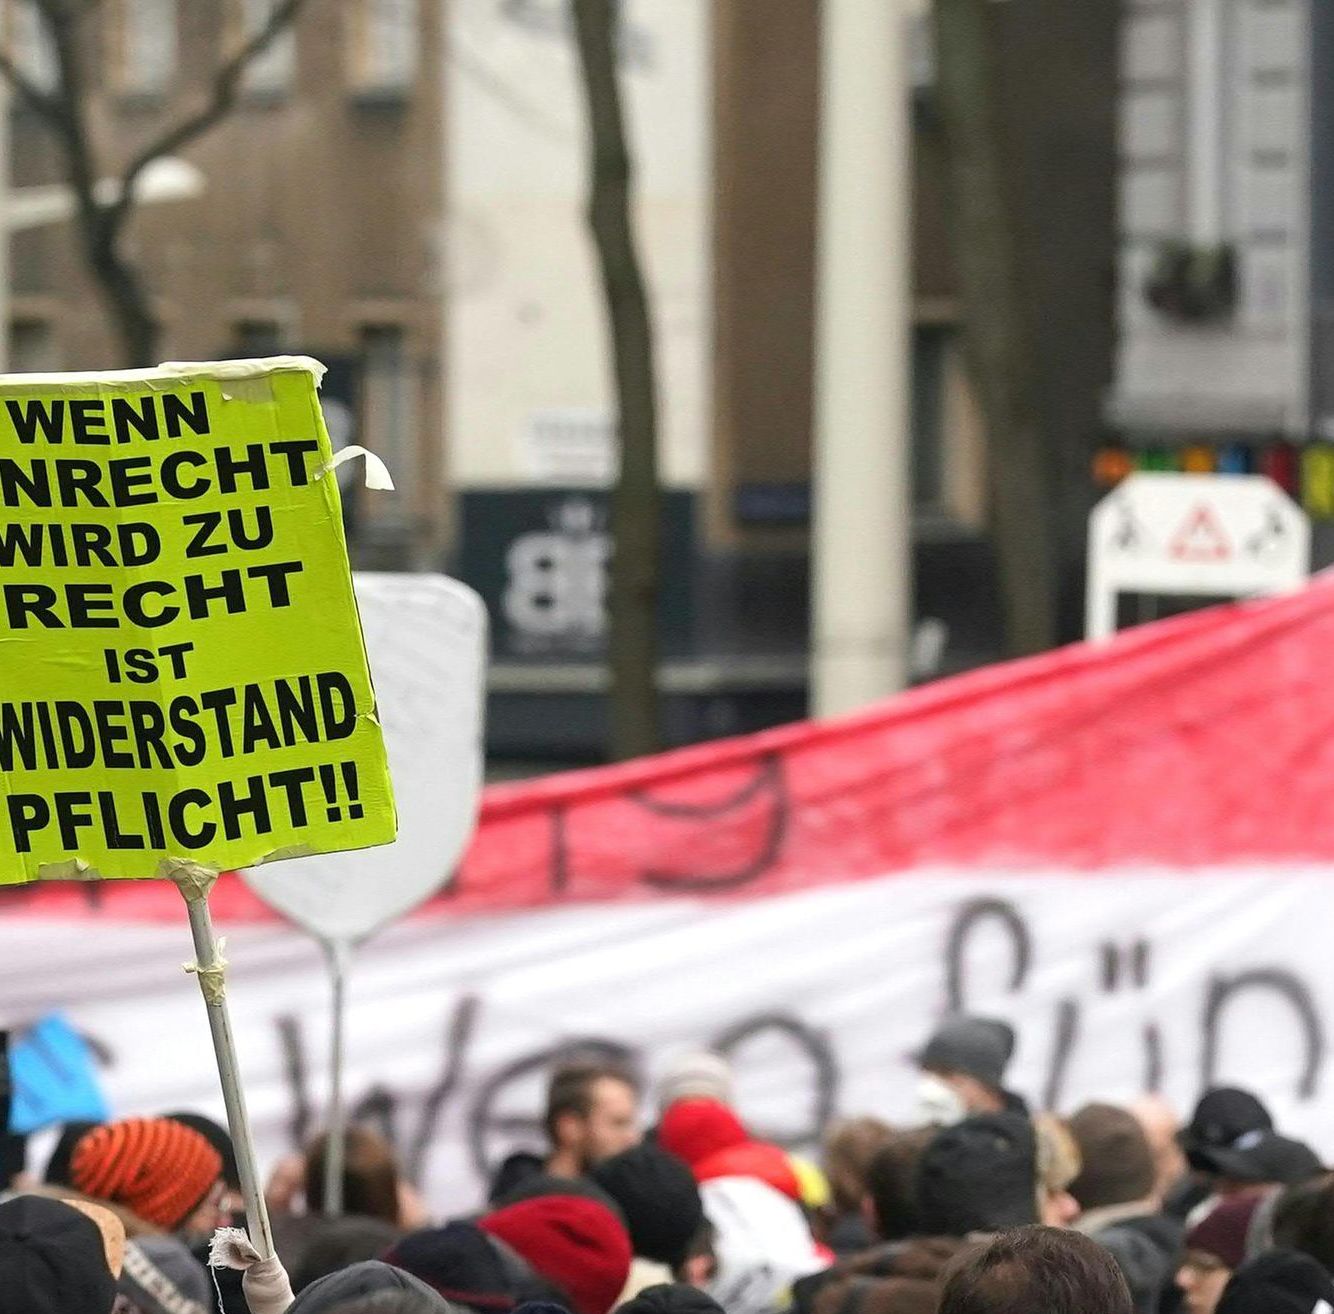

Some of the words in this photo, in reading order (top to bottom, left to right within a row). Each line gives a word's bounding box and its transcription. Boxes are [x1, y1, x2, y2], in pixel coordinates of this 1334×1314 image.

[5, 392, 210, 445] WENN
[183, 506, 273, 558] ZU
[3, 561, 303, 629] RECHT
[104, 642, 193, 683] IST
[7, 761, 363, 853] PFLICHT!!
